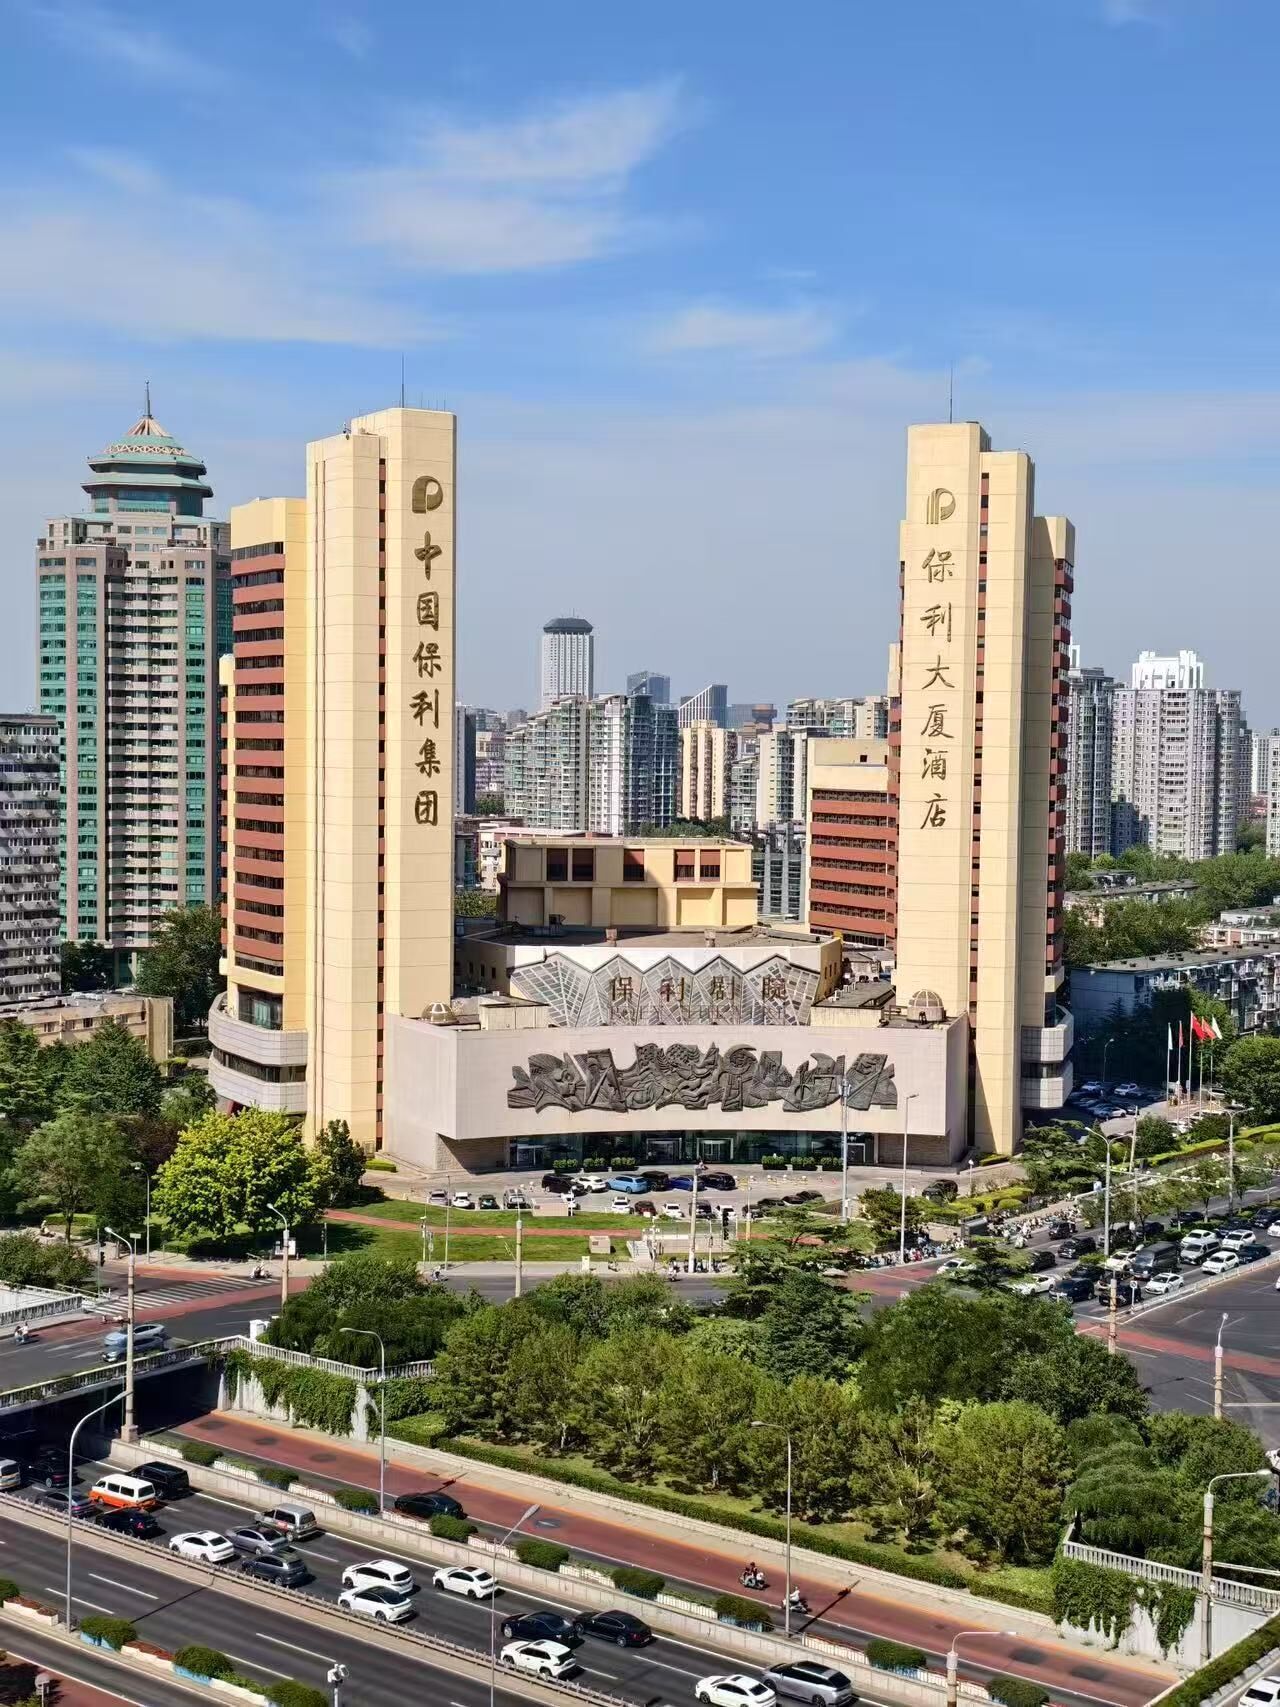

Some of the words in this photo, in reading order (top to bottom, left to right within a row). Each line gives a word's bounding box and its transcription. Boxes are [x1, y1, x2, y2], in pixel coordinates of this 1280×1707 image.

[409, 530, 443, 827] 中国保利集团
[920, 547, 956, 830] 保利大厦酒店
[609, 975, 787, 1002] 保利剧院
